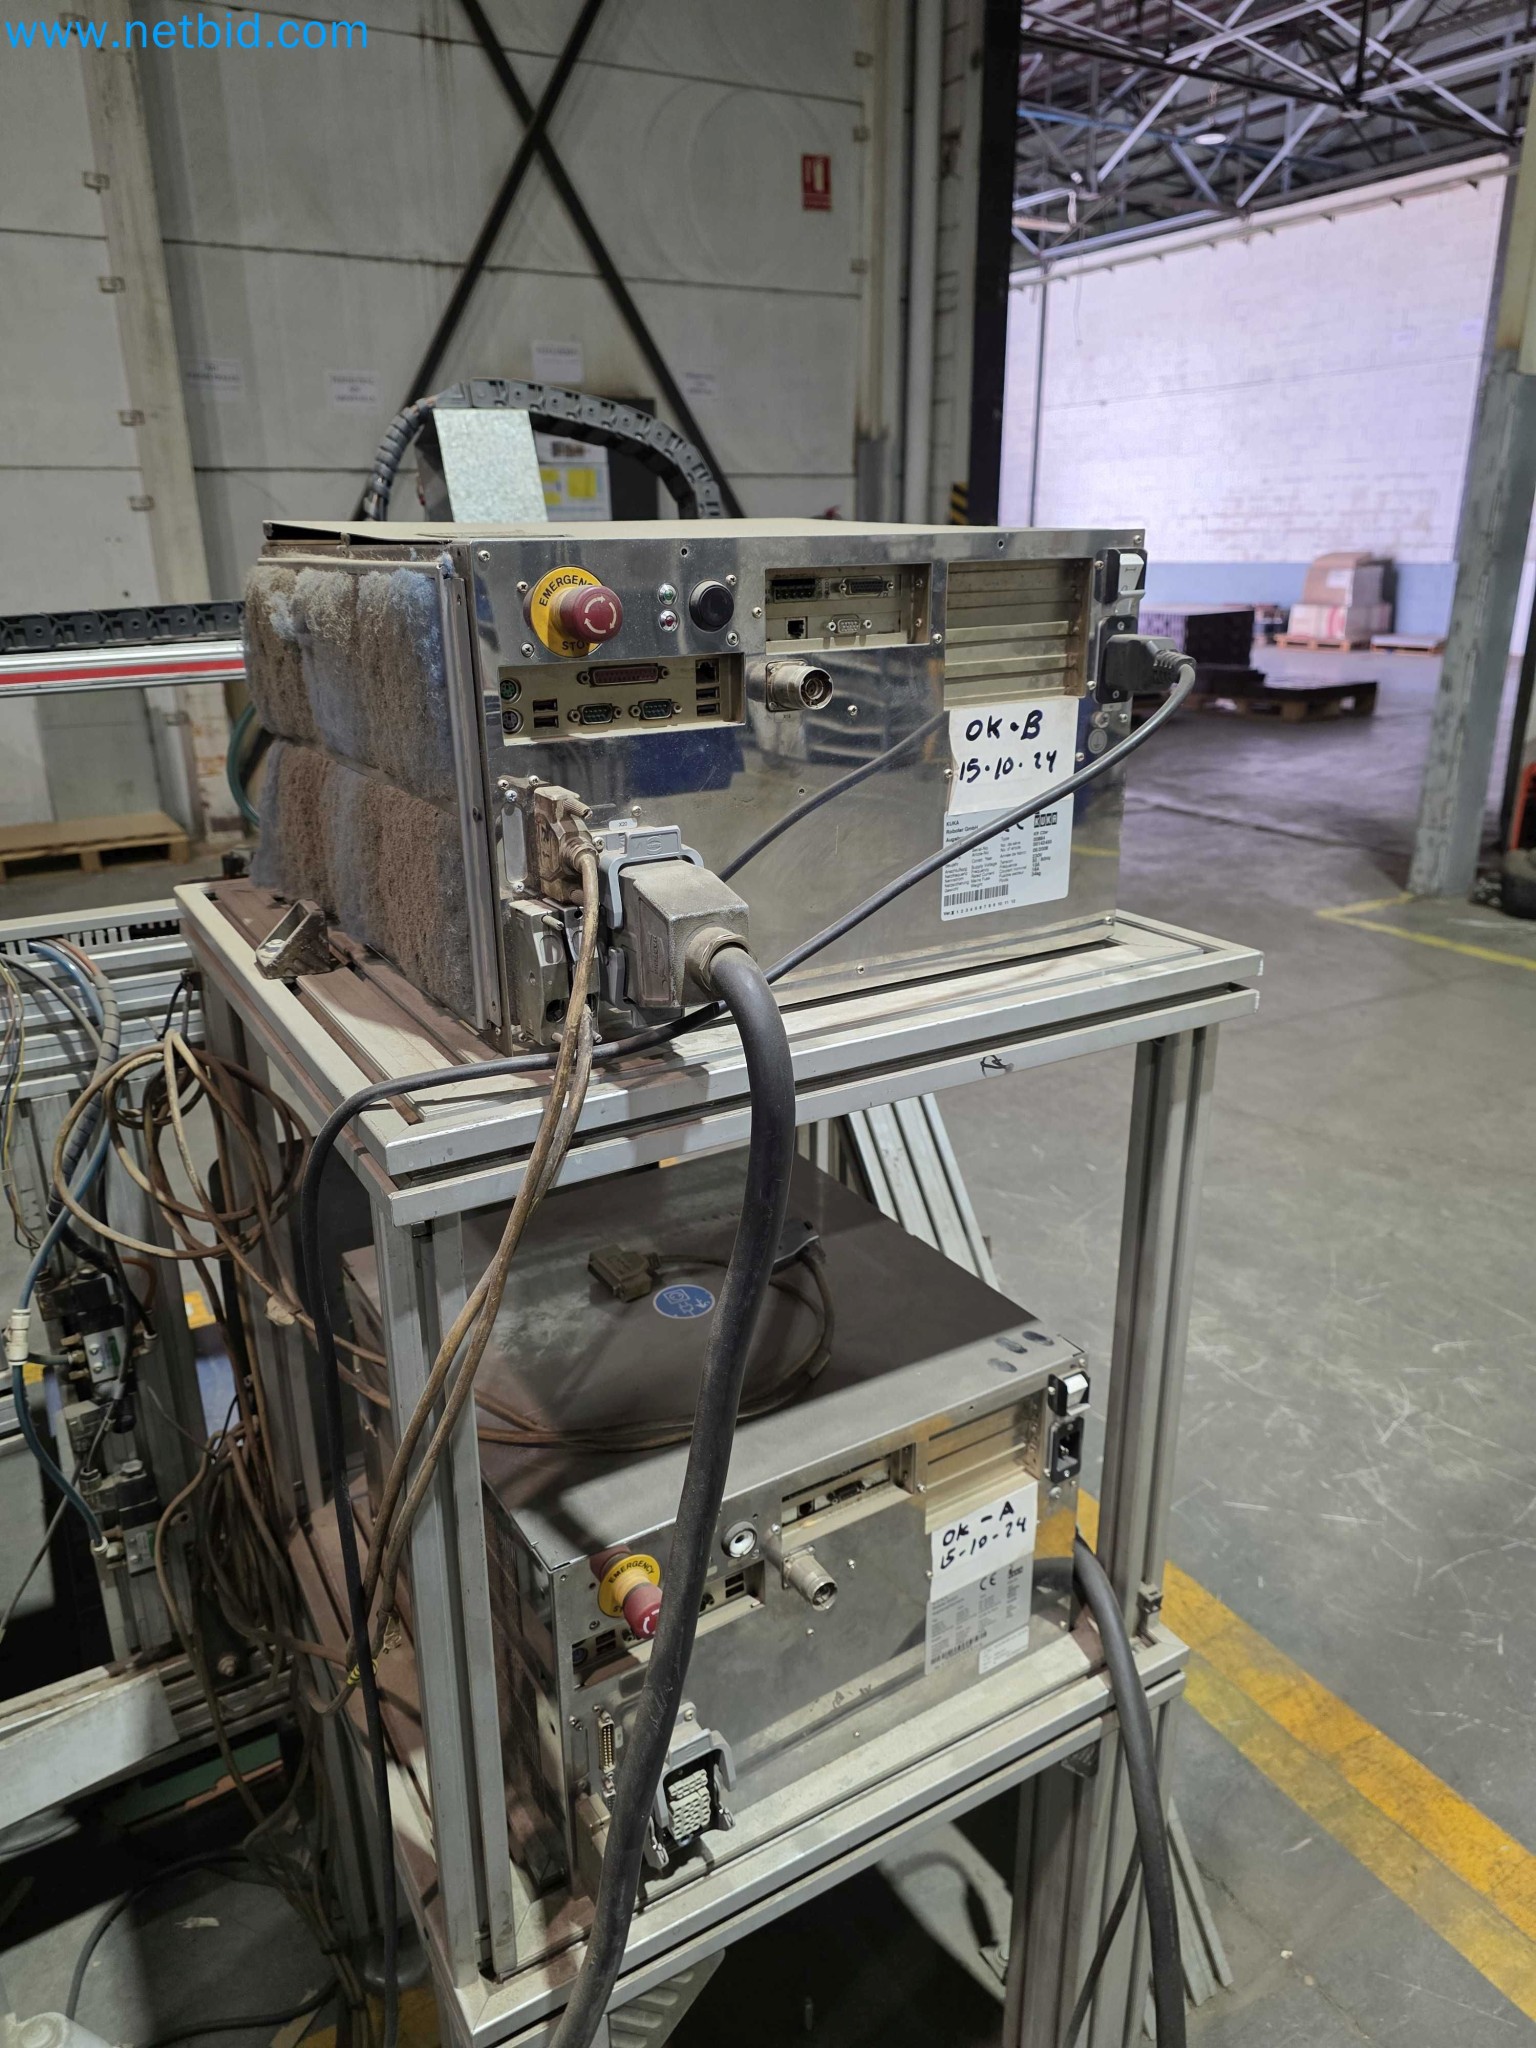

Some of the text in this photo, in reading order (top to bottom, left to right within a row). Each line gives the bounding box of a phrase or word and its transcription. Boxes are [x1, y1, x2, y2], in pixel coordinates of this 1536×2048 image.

[538, 574, 593, 607] EMERGEN
[562, 640, 588, 652] STO
[608, 1560, 655, 1585] EMERGENCY
